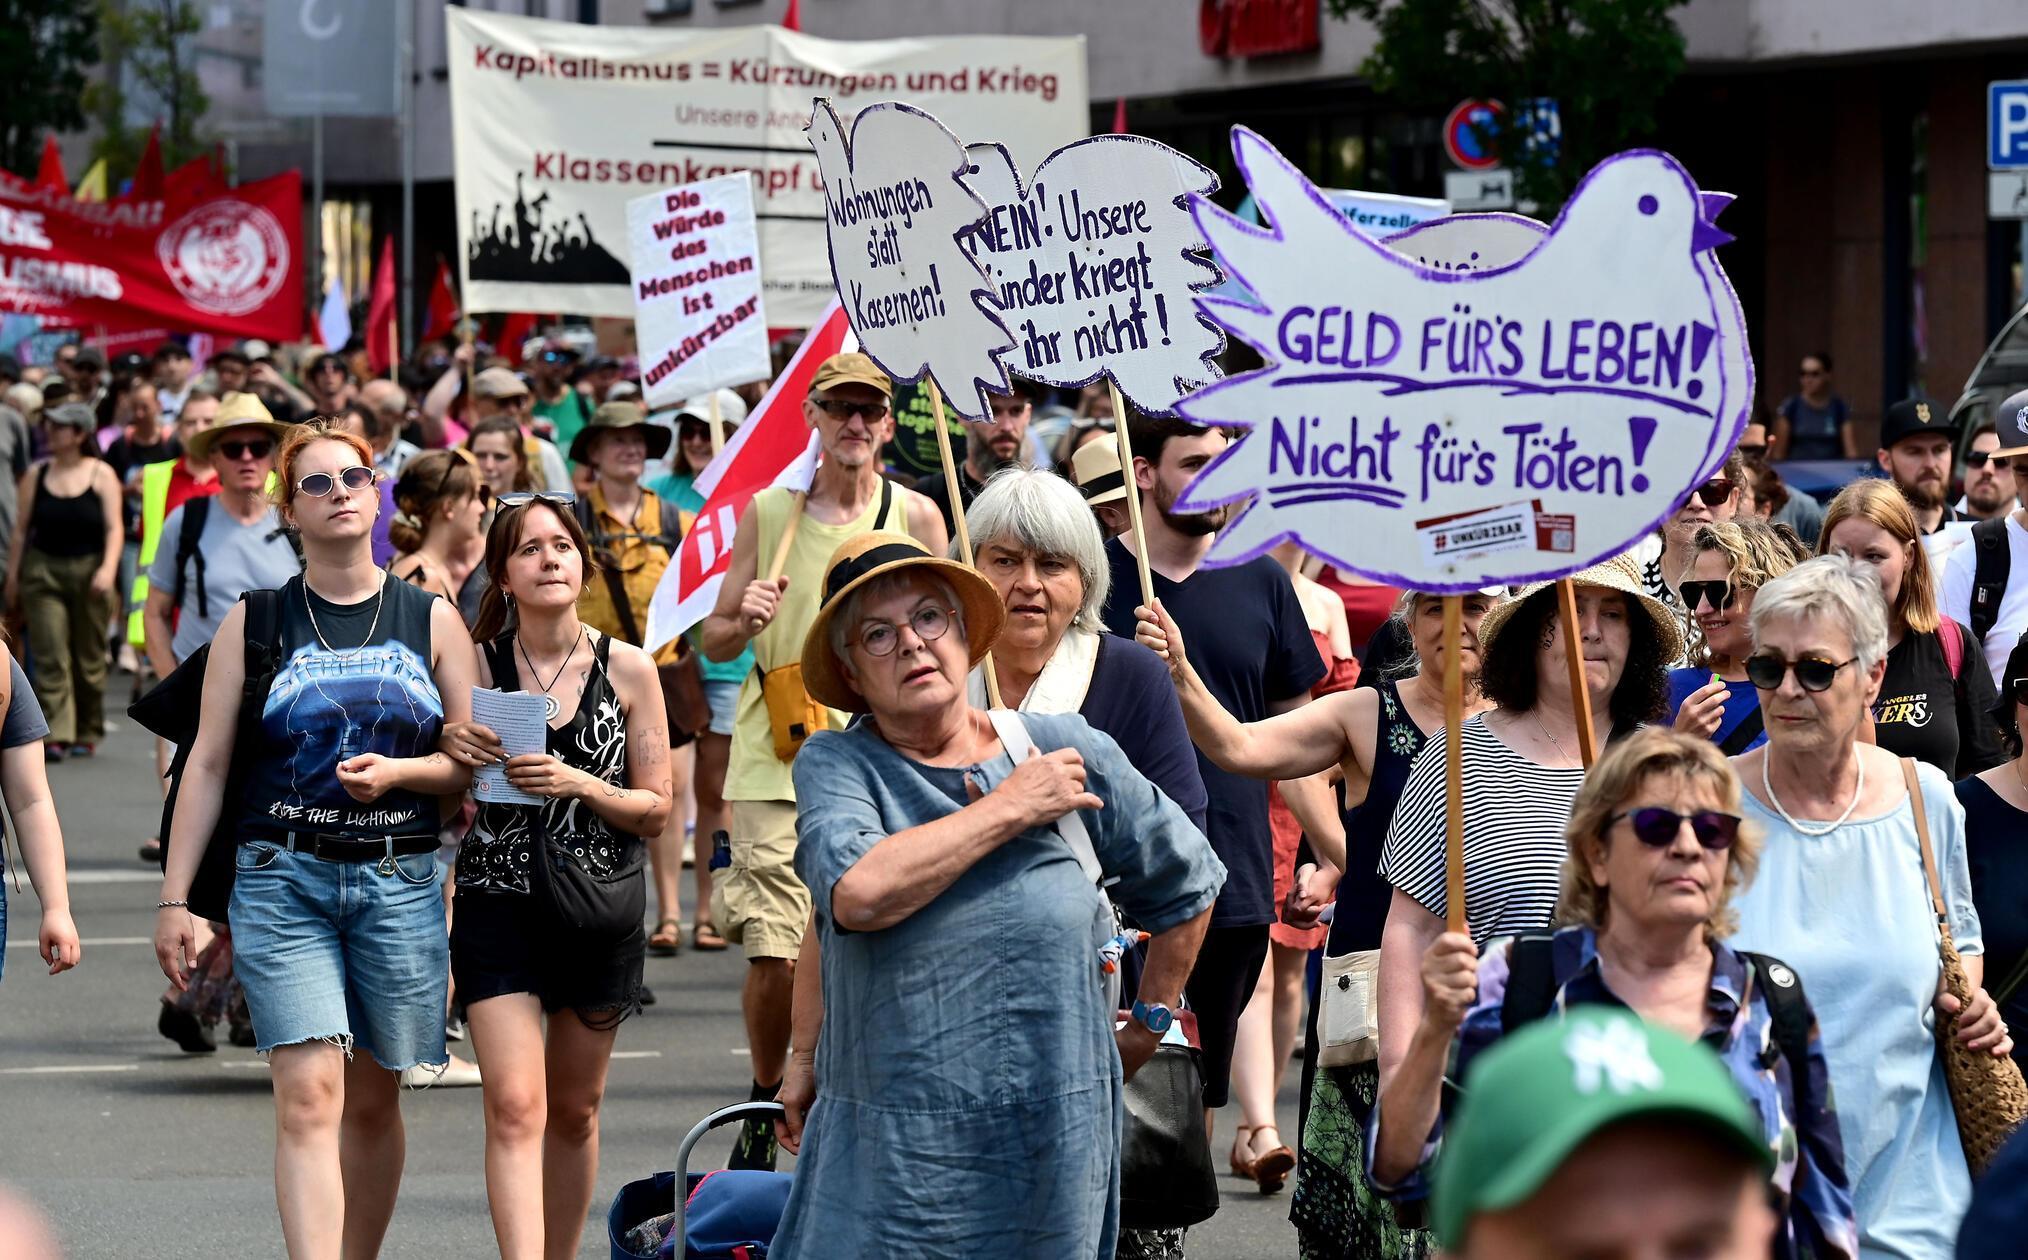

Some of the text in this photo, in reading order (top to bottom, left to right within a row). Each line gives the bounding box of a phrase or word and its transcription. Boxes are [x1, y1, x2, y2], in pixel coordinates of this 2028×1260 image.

[475, 45, 691, 80] Kapitalismus
[730, 58, 897, 96] Kürzungen
[907, 68, 969, 92] und
[978, 66, 1058, 101] Krieg
[675, 104, 760, 129] Unsere
[2000, 93, 2028, 158] P
[653, 208, 725, 241] Würde
[666, 190, 701, 213] Die
[824, 177, 933, 229] Wohnungen
[966, 183, 1151, 256] NEIN! Unsere
[671, 239, 707, 261] des
[867, 221, 901, 268] statt
[640, 256, 753, 300] Menschen
[850, 263, 945, 331] Kasernen!
[985, 259, 1066, 310] inder
[683, 292, 714, 316] ist
[645, 295, 758, 387] unkürzbar
[1019, 319, 1061, 369] ihr
[1278, 306, 1401, 368] GELD
[1541, 319, 1716, 400] LEBEN!
[1269, 416, 1400, 481] Nicht
[1503, 416, 1658, 496] Töten!
[1882, 693, 1928, 705] ANGELES
[269, 801, 304, 819] RIDE
[306, 809, 340, 823] THE
